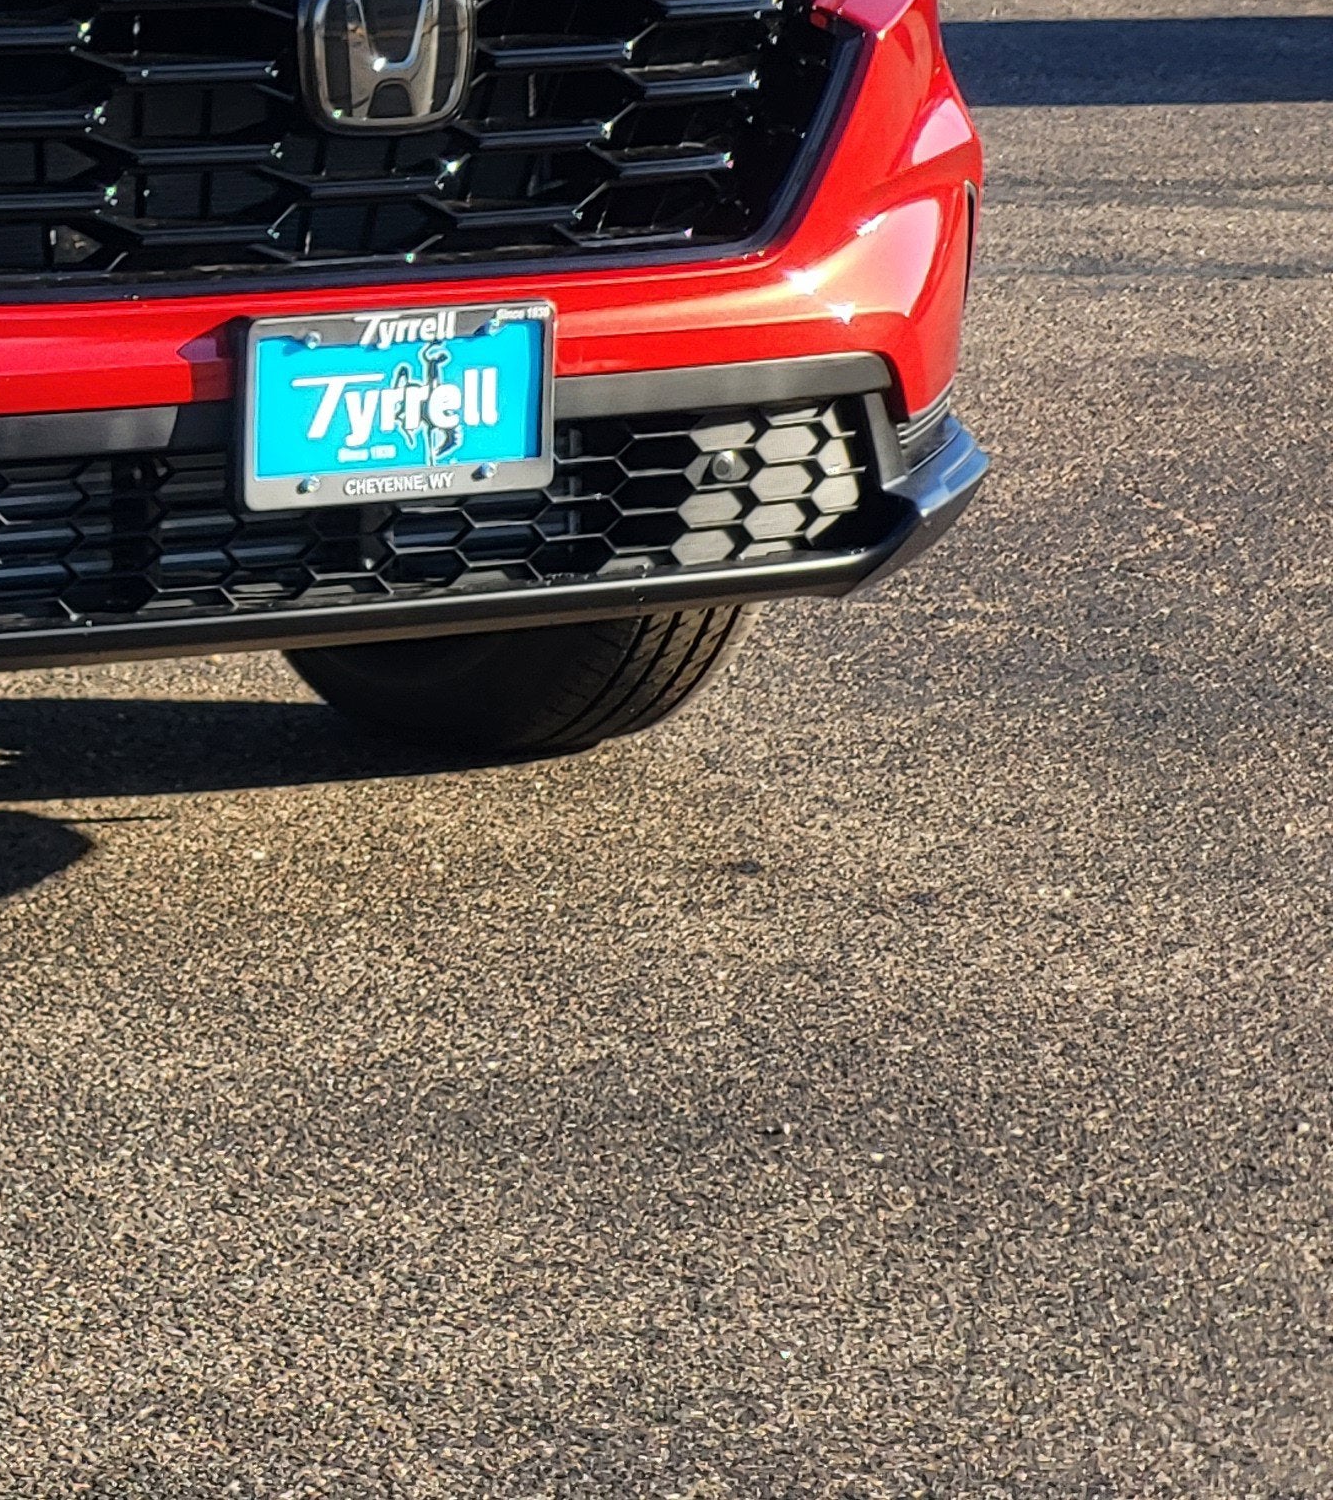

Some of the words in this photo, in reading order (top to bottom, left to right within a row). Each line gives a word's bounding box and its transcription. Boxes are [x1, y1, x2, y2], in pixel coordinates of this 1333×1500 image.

[353, 310, 457, 350] Tyrrell
[291, 367, 498, 447] Tyrrell
[345, 474, 428, 496] CHEYENNE,
[429, 472, 454, 489] WY
